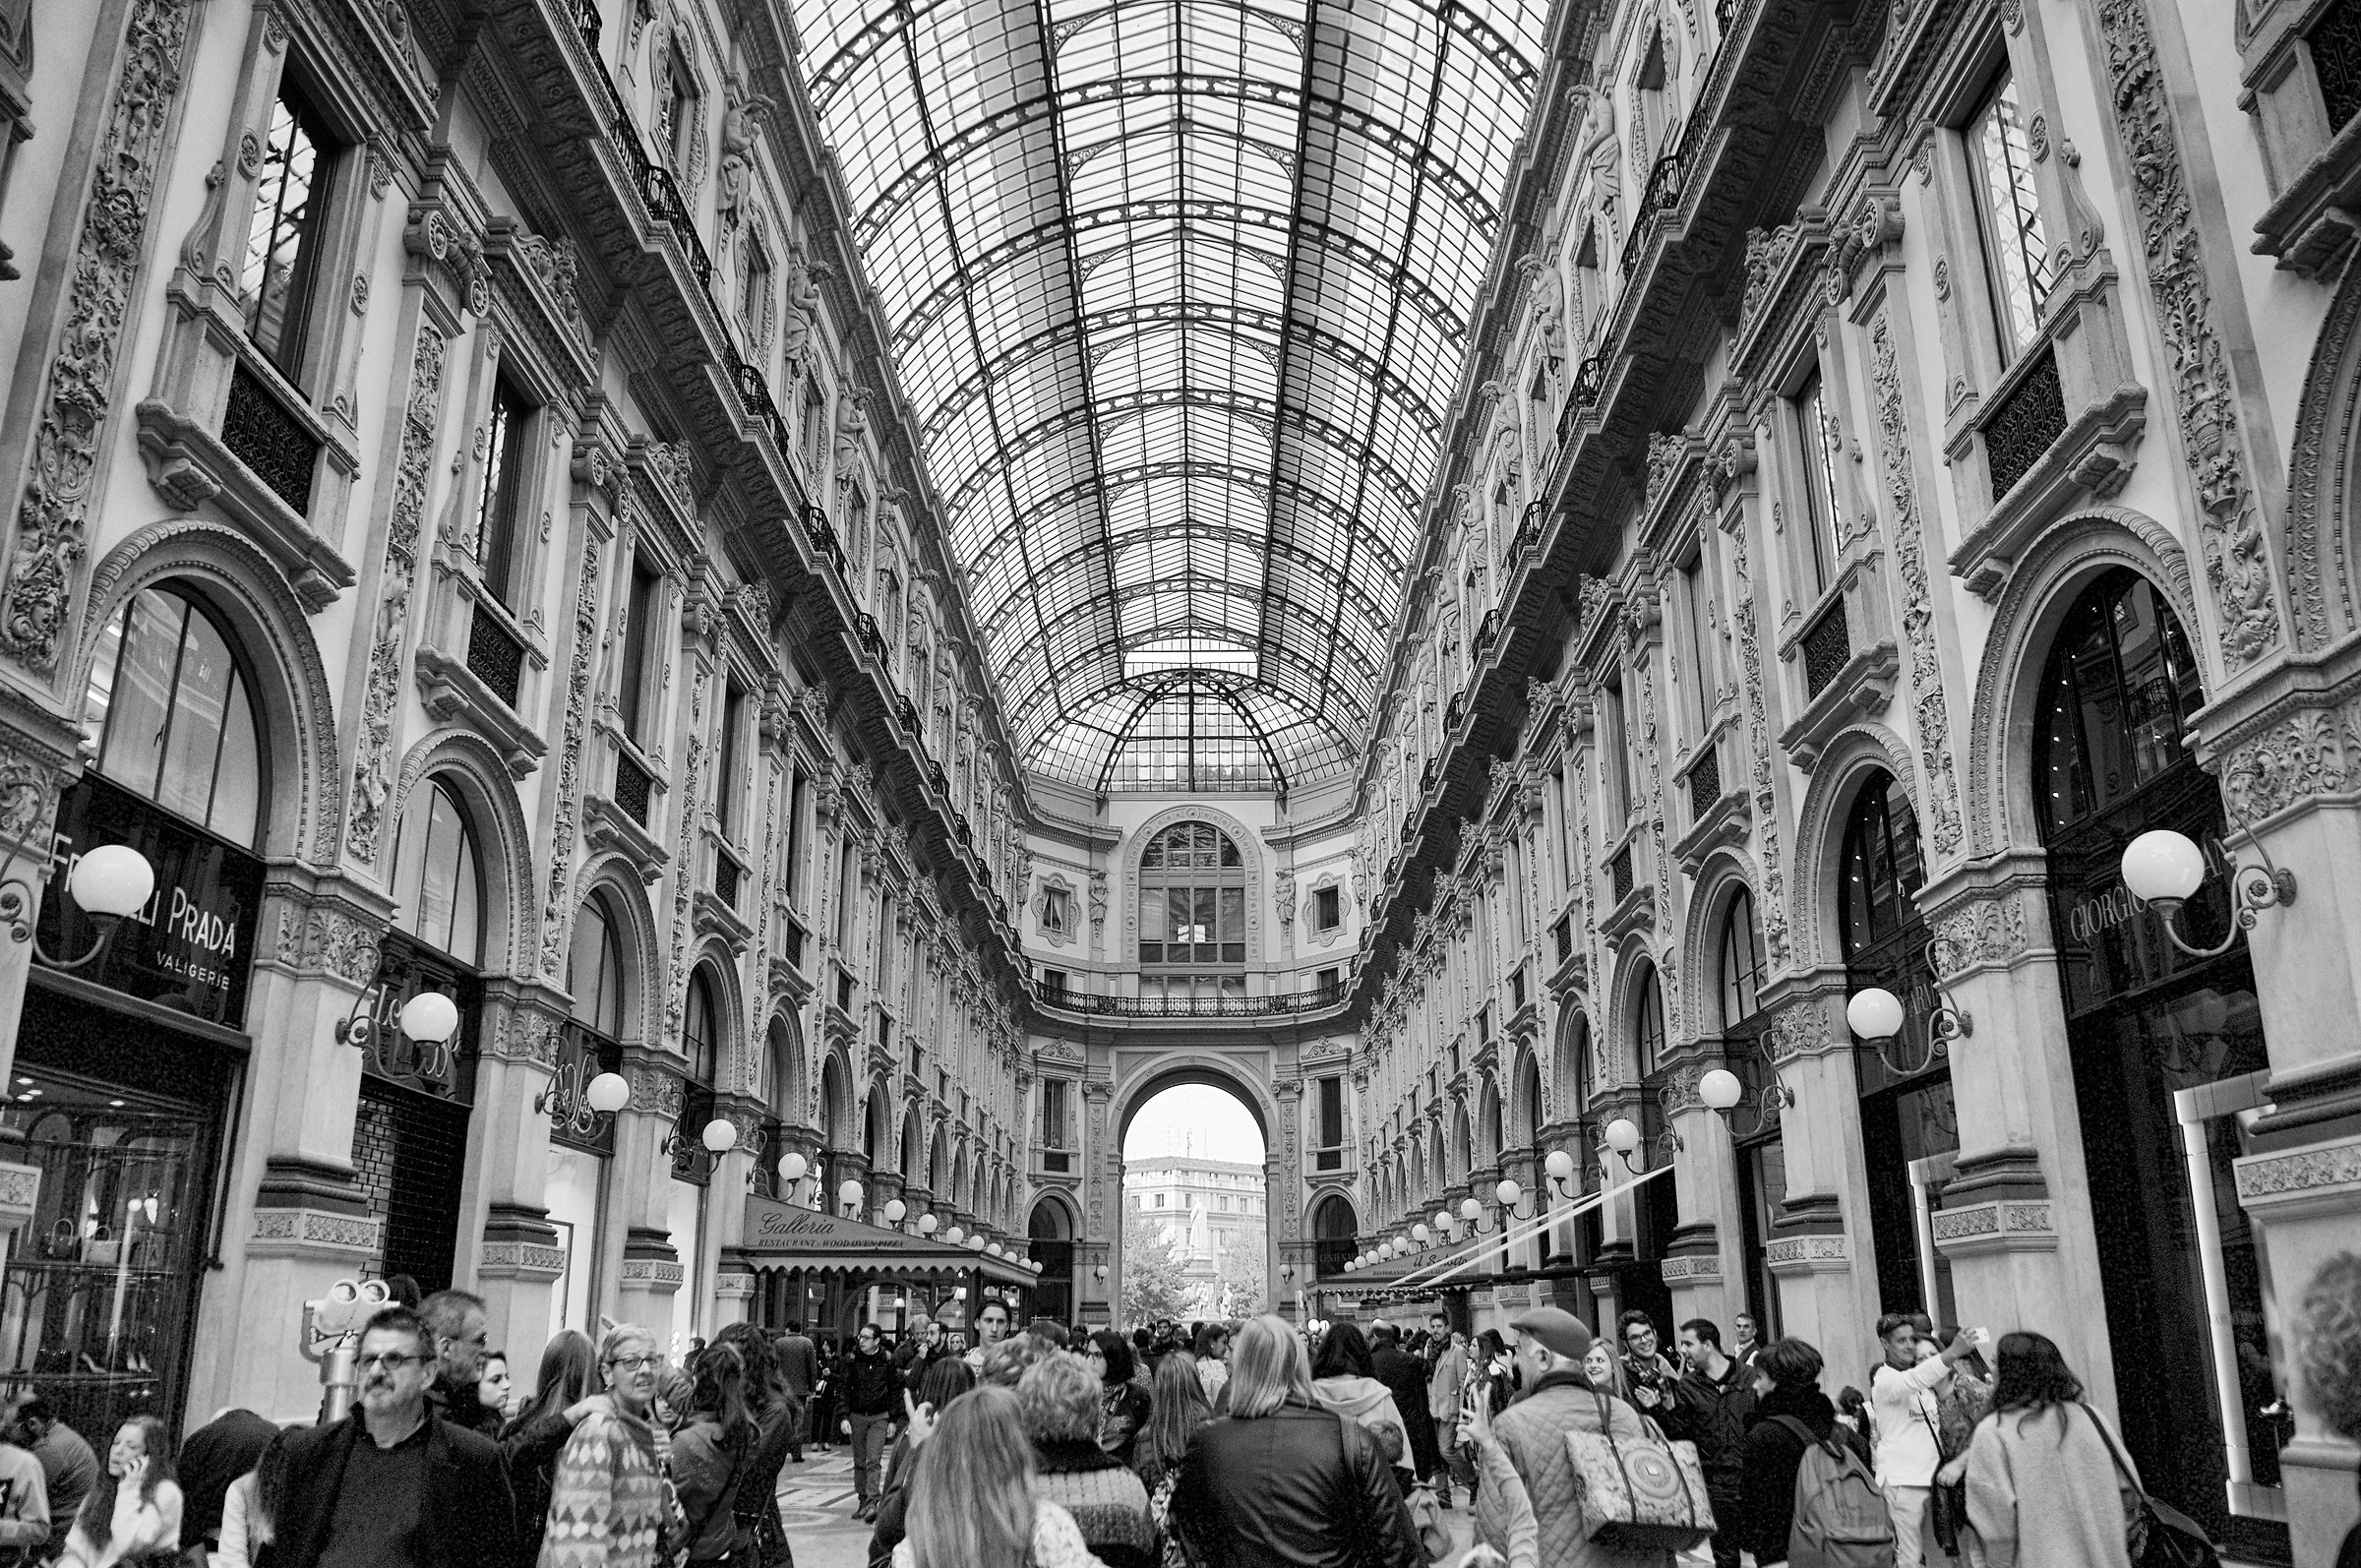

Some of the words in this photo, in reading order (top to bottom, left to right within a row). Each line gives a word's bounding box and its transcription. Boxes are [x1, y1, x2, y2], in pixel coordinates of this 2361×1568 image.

[167, 886, 235, 959] PRADA
[156, 951, 231, 991] VALIGERIE
[757, 1212, 835, 1235] Galleria
[757, 1238, 817, 1247] RESTAURANT
[823, 1238, 851, 1247] WOOD
[851, 1239, 876, 1248] OVEN
[1413, 1254, 1423, 1267] il
